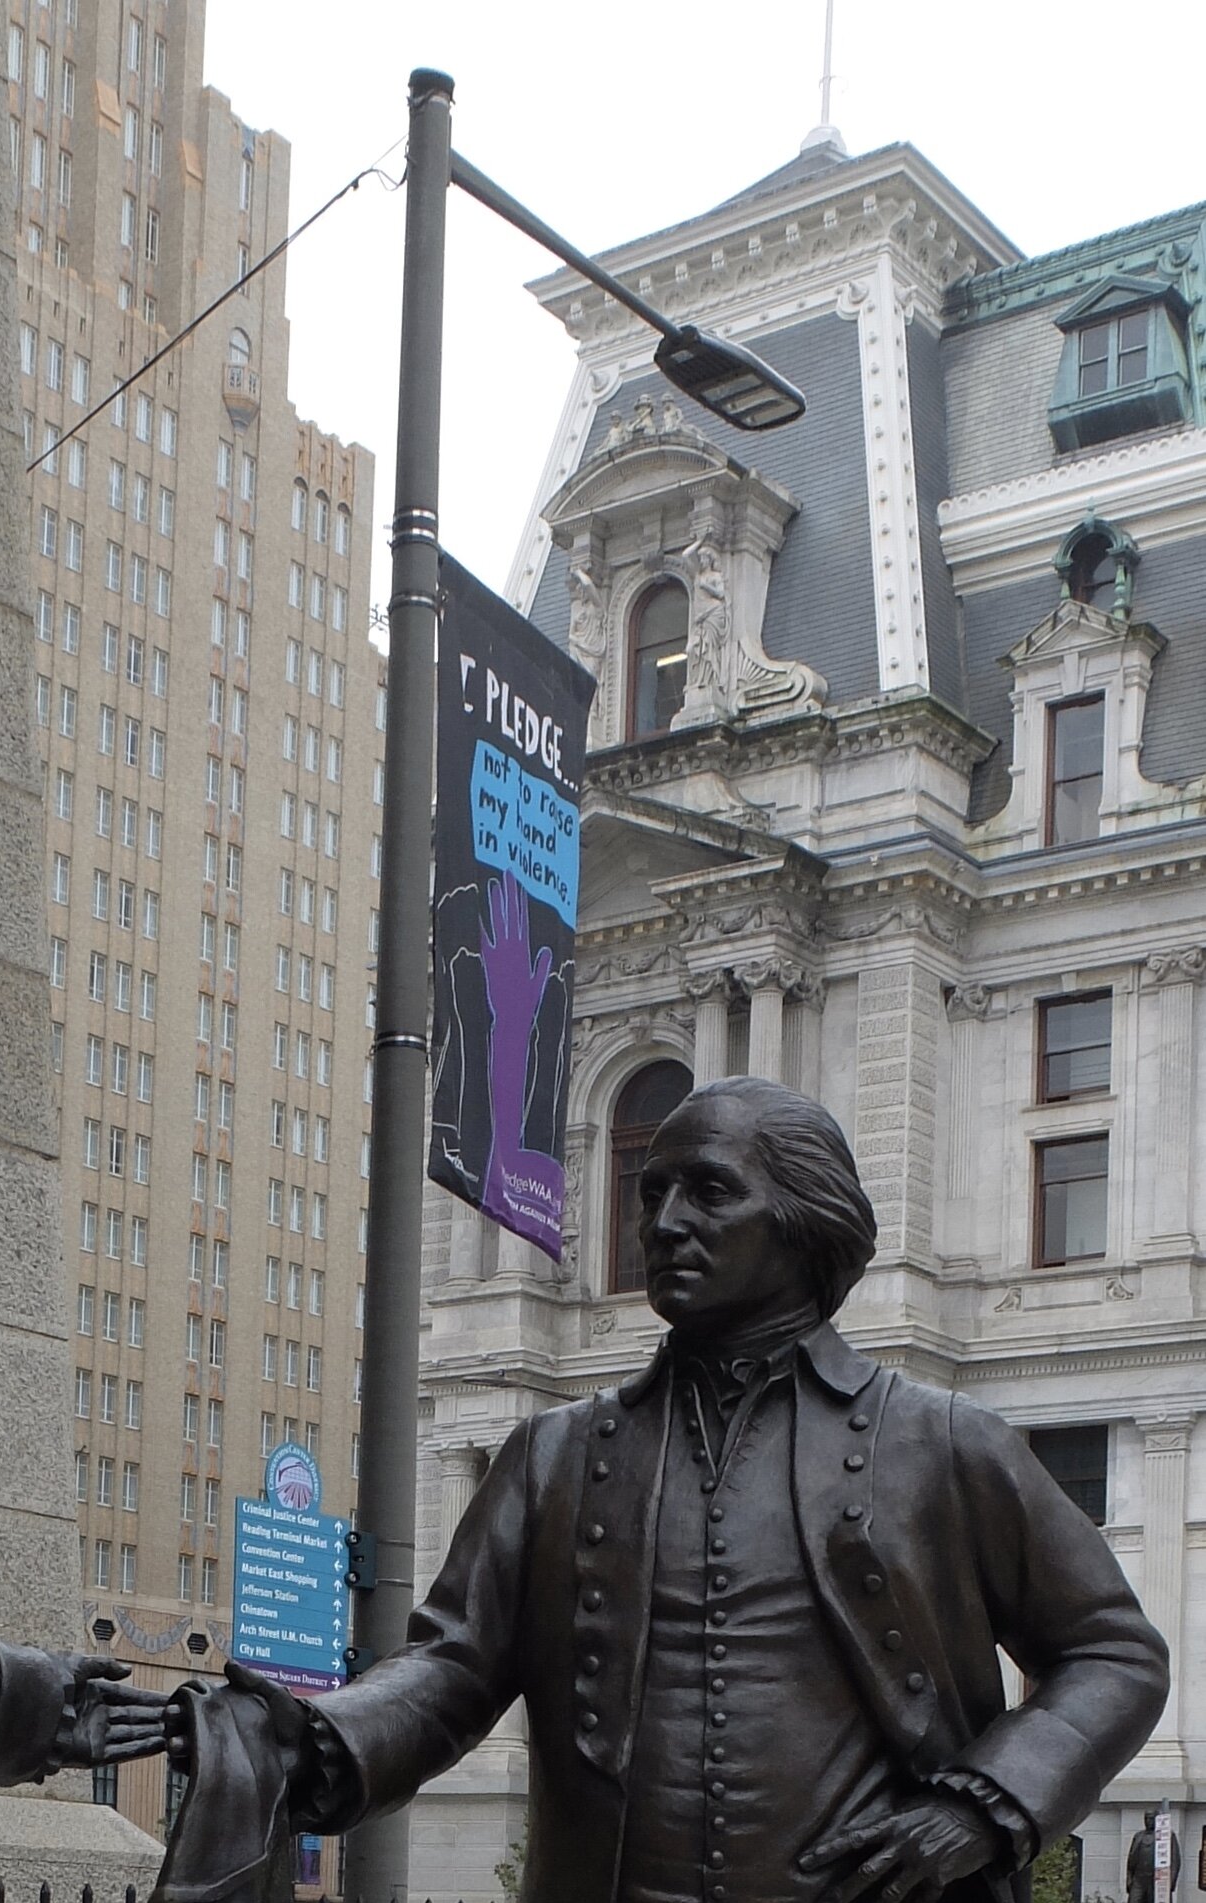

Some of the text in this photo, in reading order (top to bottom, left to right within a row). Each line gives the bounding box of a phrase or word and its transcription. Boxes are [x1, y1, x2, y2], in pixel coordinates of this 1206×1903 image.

[486, 667, 579, 793] PLEDGE...
[484, 750, 511, 783] not
[519, 768, 532, 805] to
[479, 787, 557, 856] my hand
[479, 823, 498, 852] in
[242, 1502, 320, 1528] Criminal Justice Center
[242, 1522, 328, 1549] Reading Terminal Market
[242, 1542, 305, 1564] Convention Center
[241, 1563, 318, 1589] Market East Shopping
[242, 1583, 299, 1603] Jefferson Station
[240, 1603, 278, 1619] Chinatown
[239, 1622, 323, 1647] Arch Street U.M. Church
[239, 1643, 271, 1658] City Hall
